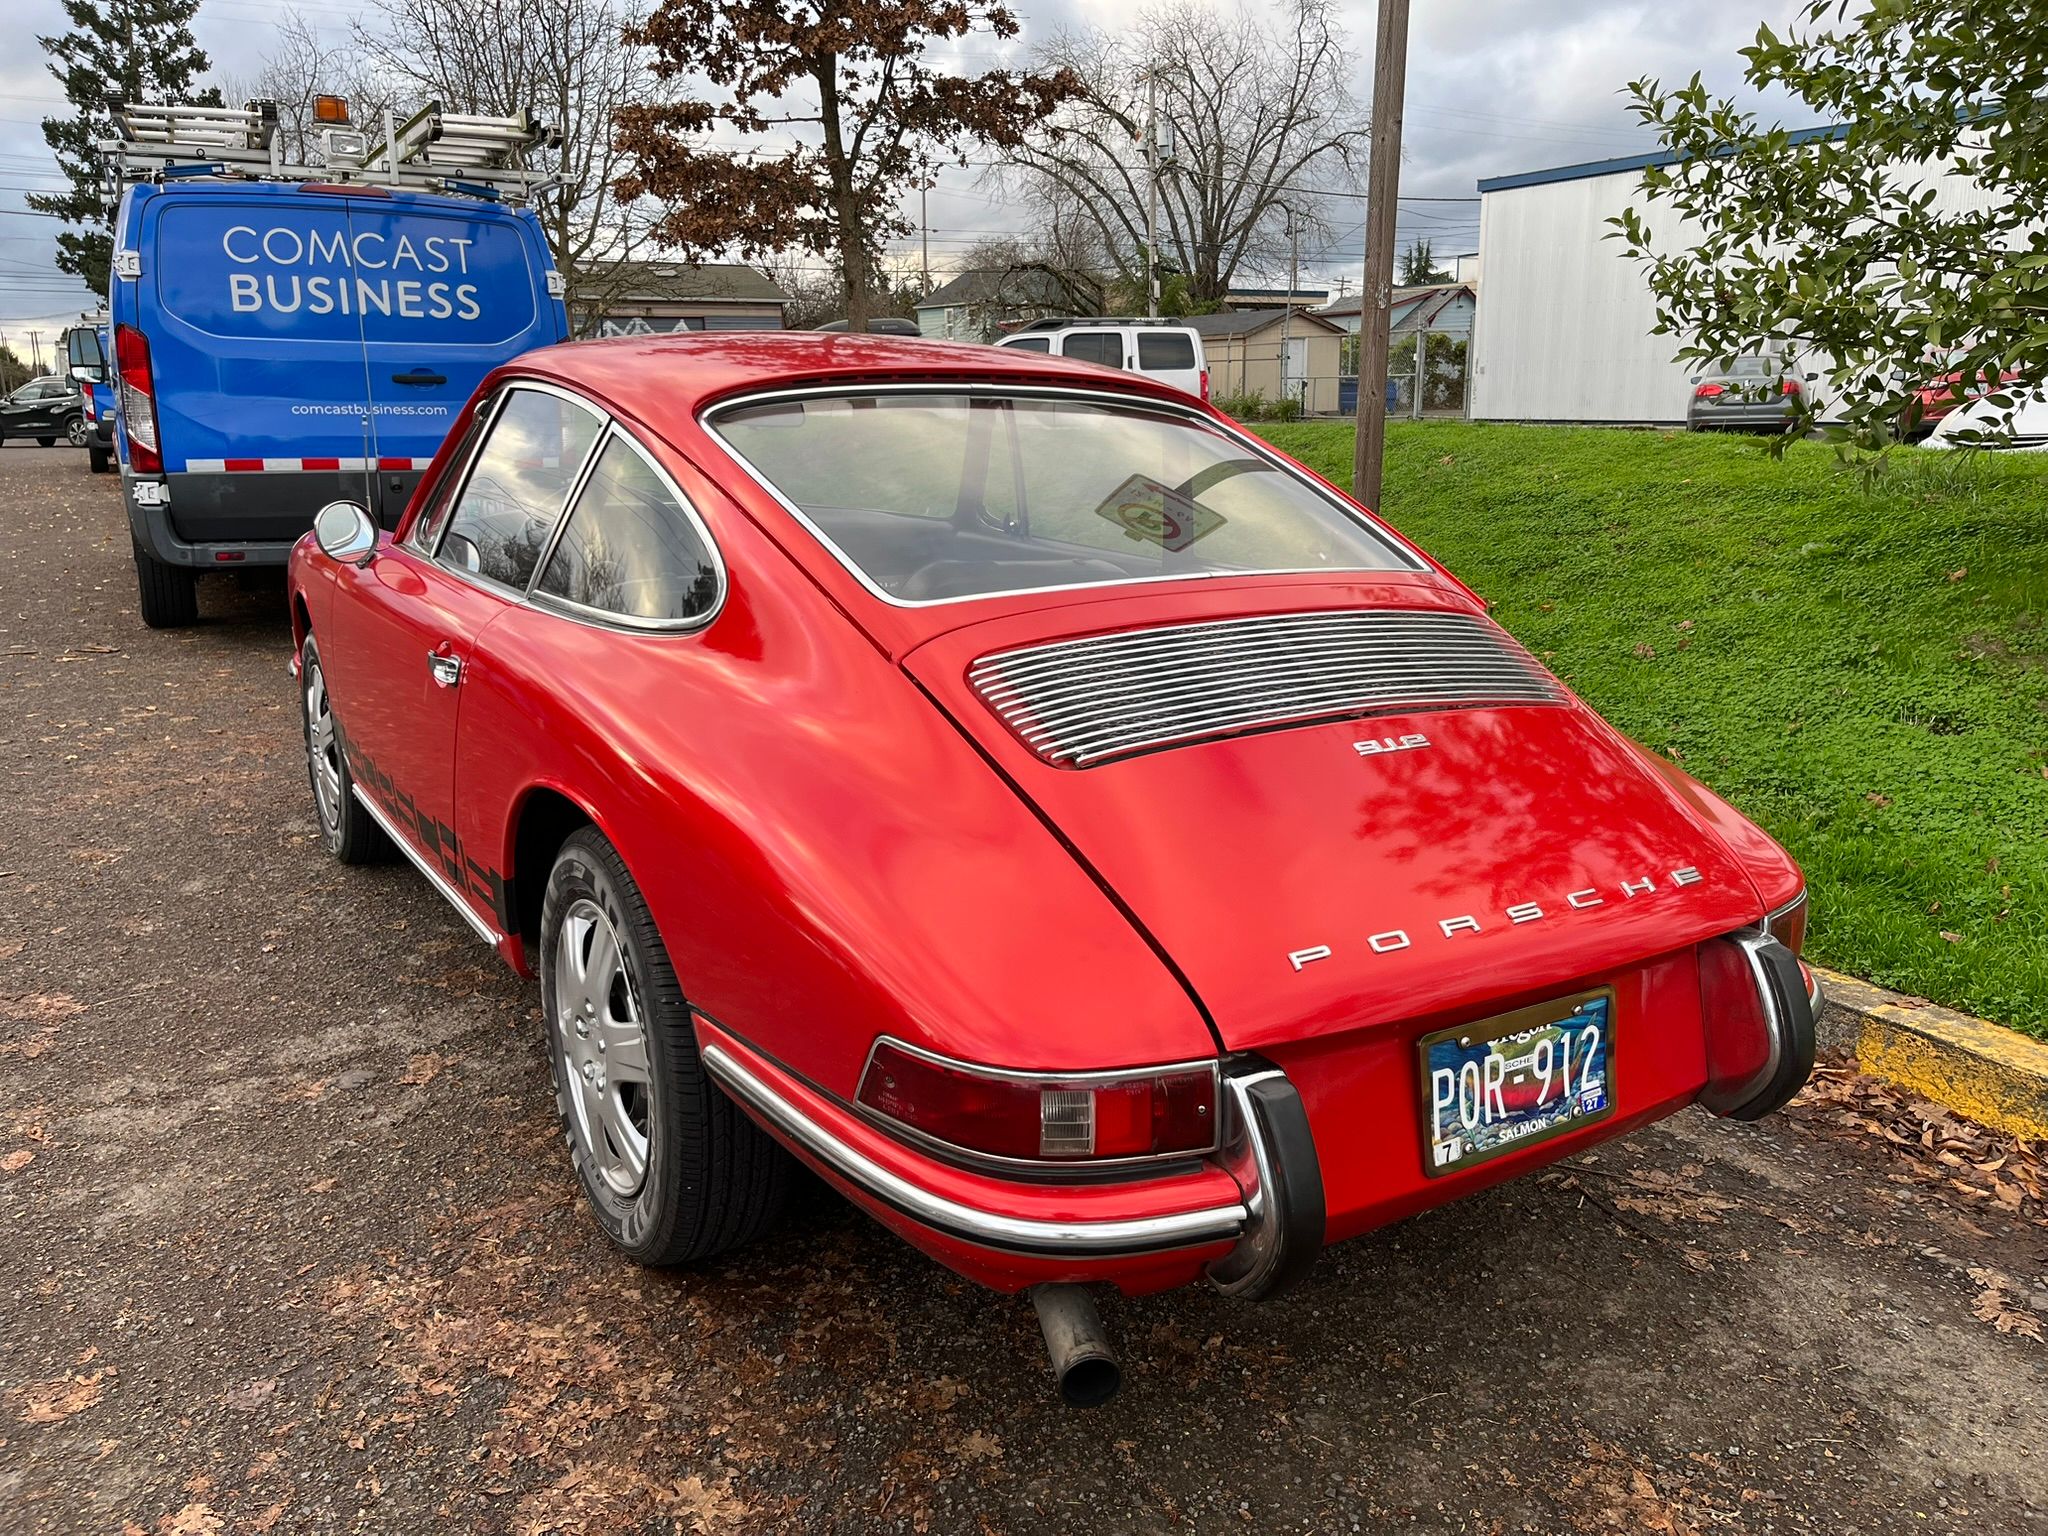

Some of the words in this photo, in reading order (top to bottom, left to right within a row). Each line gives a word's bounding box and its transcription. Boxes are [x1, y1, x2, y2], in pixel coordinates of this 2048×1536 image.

[223, 226, 473, 274] COMCAST
[229, 274, 481, 320] BUSINESS
[291, 403, 448, 416] comcastbusiness.com
[1353, 733, 1431, 756] 912
[1287, 866, 1704, 972] PORSCHE
[1586, 1097, 1599, 1111] 27
[1498, 1117, 1547, 1143] SALMON
[1442, 1144, 1452, 1163] 7
